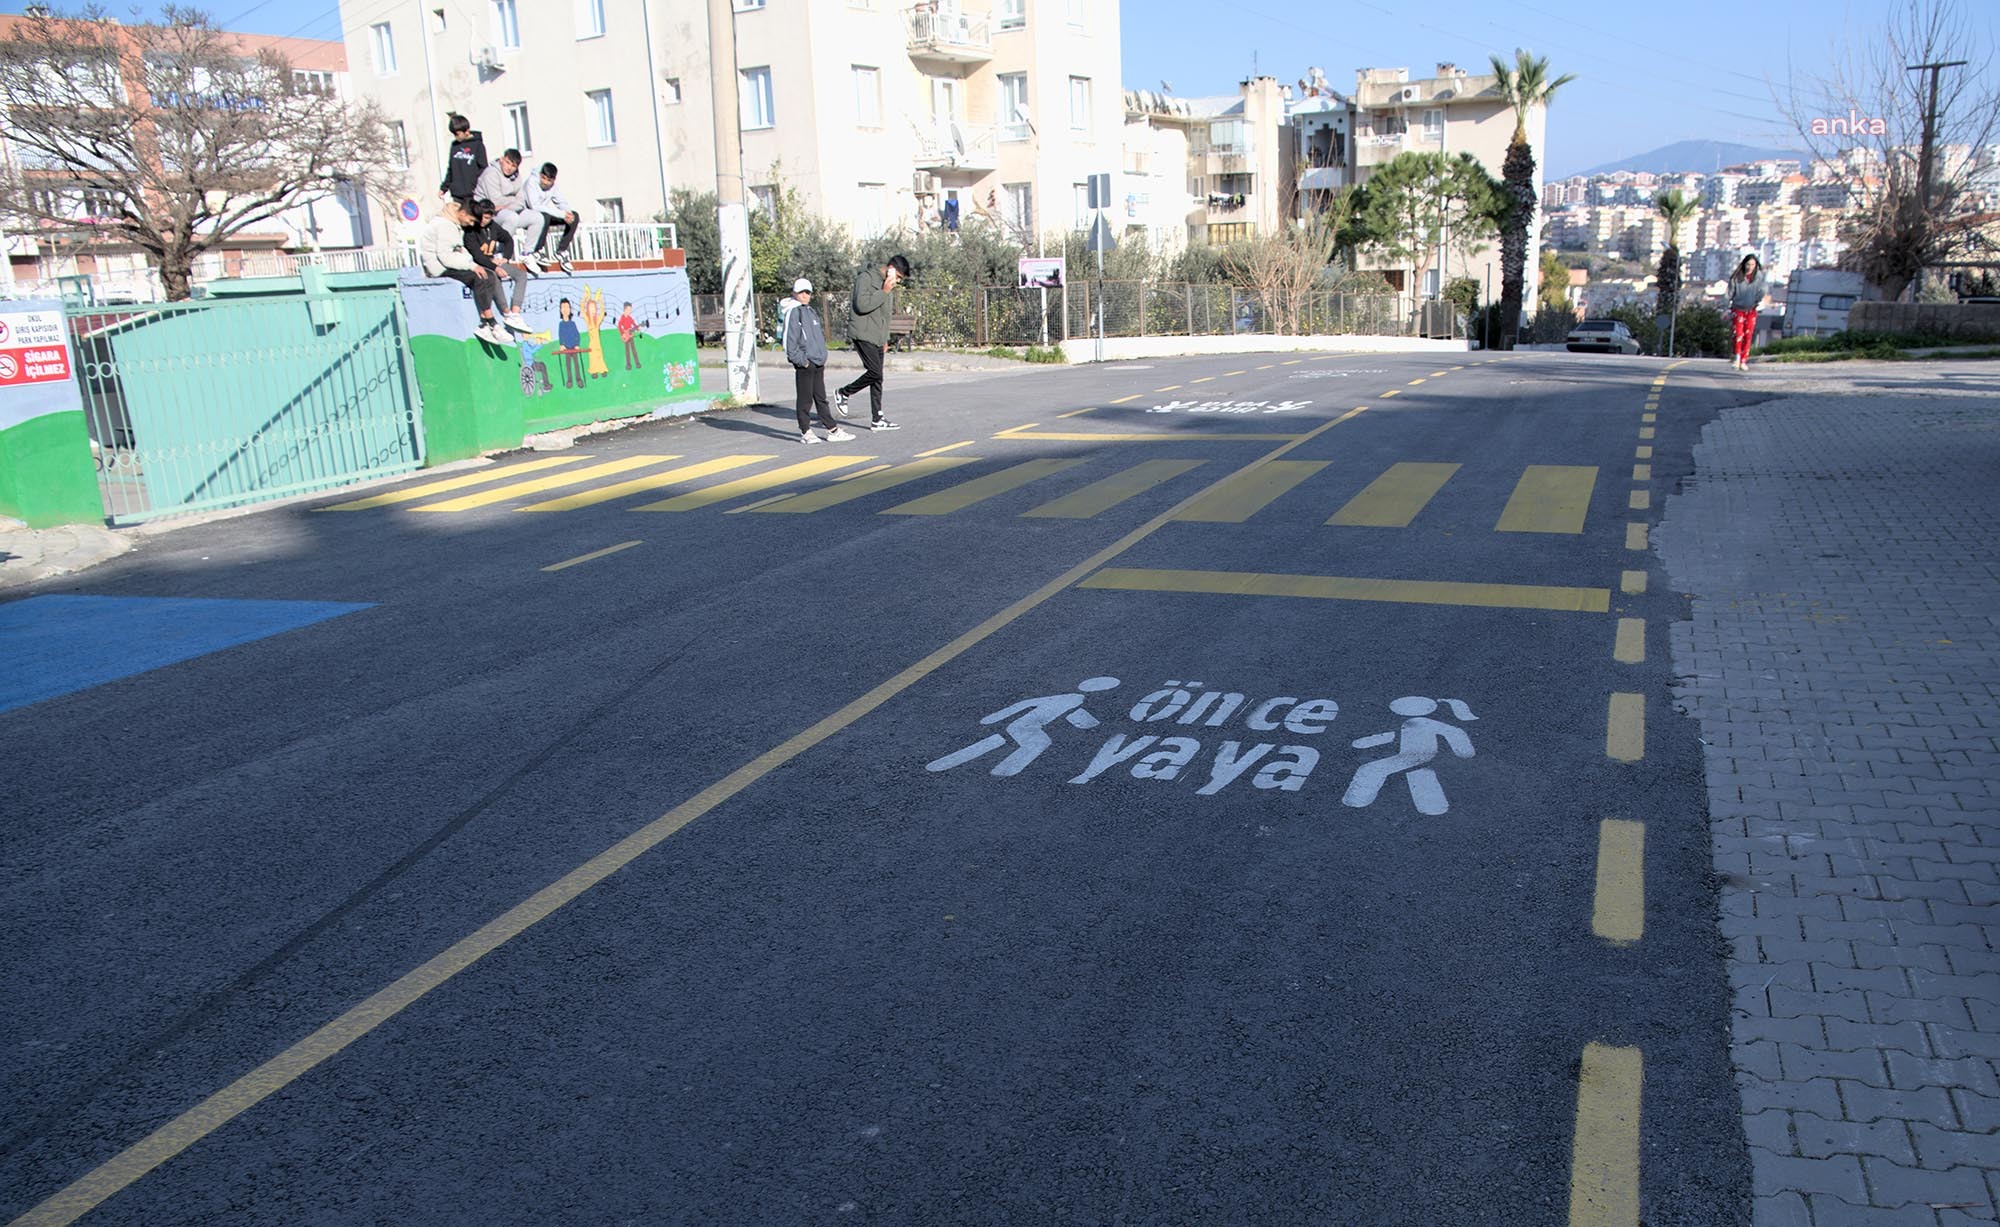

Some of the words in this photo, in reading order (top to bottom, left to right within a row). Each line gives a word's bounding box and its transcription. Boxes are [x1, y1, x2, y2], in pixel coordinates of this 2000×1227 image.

[18, 336, 32, 344] PARK
[24, 350, 61, 363] SİGARA
[24, 363, 66, 379] İÇİLMEZ
[1129, 680, 1340, 734] önce
[1067, 733, 1321, 795] yaya
